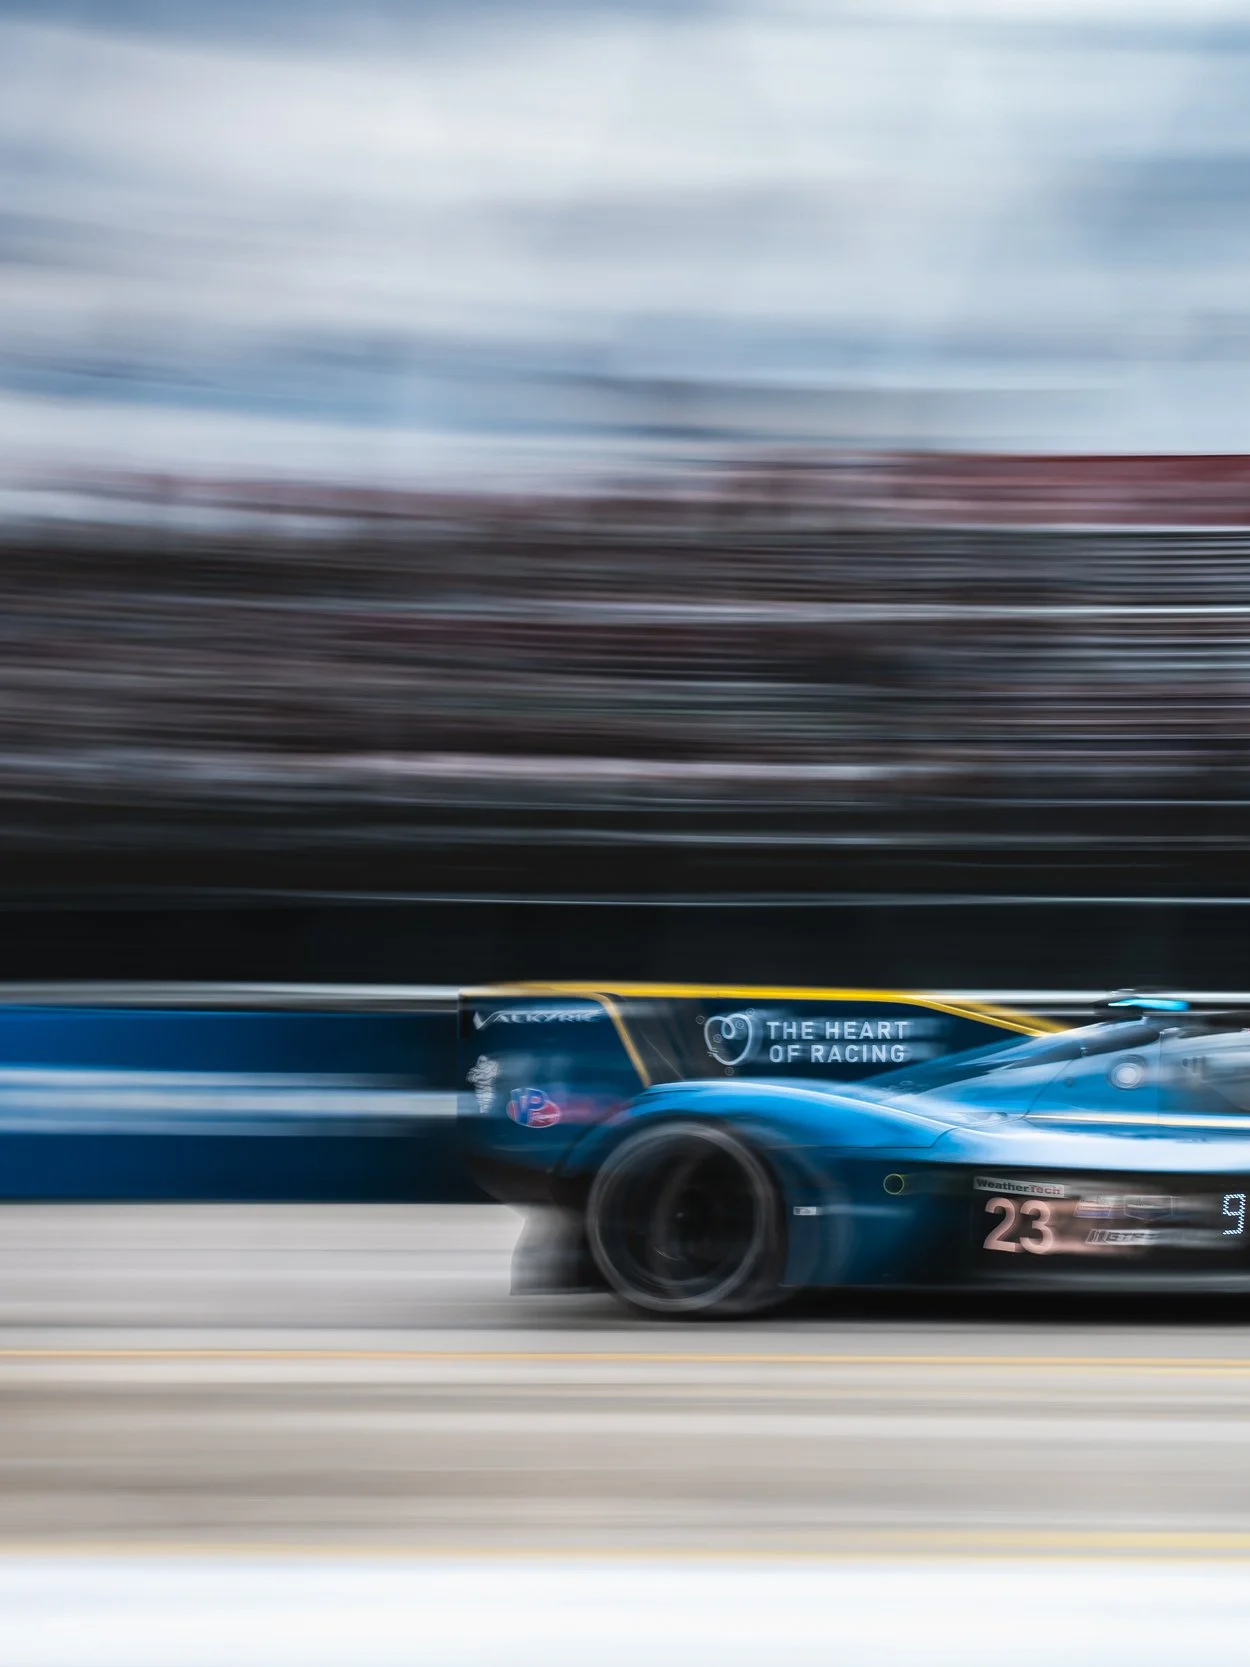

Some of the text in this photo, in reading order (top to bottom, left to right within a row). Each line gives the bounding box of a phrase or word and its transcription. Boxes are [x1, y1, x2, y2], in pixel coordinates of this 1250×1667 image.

[766, 1021, 909, 1039] THE HEART
[769, 1045, 905, 1063] OF RACING
[976, 1178, 1061, 1195] WeatherTech
[1222, 1193, 1247, 1236] 9
[982, 1197, 1054, 1256] 23
